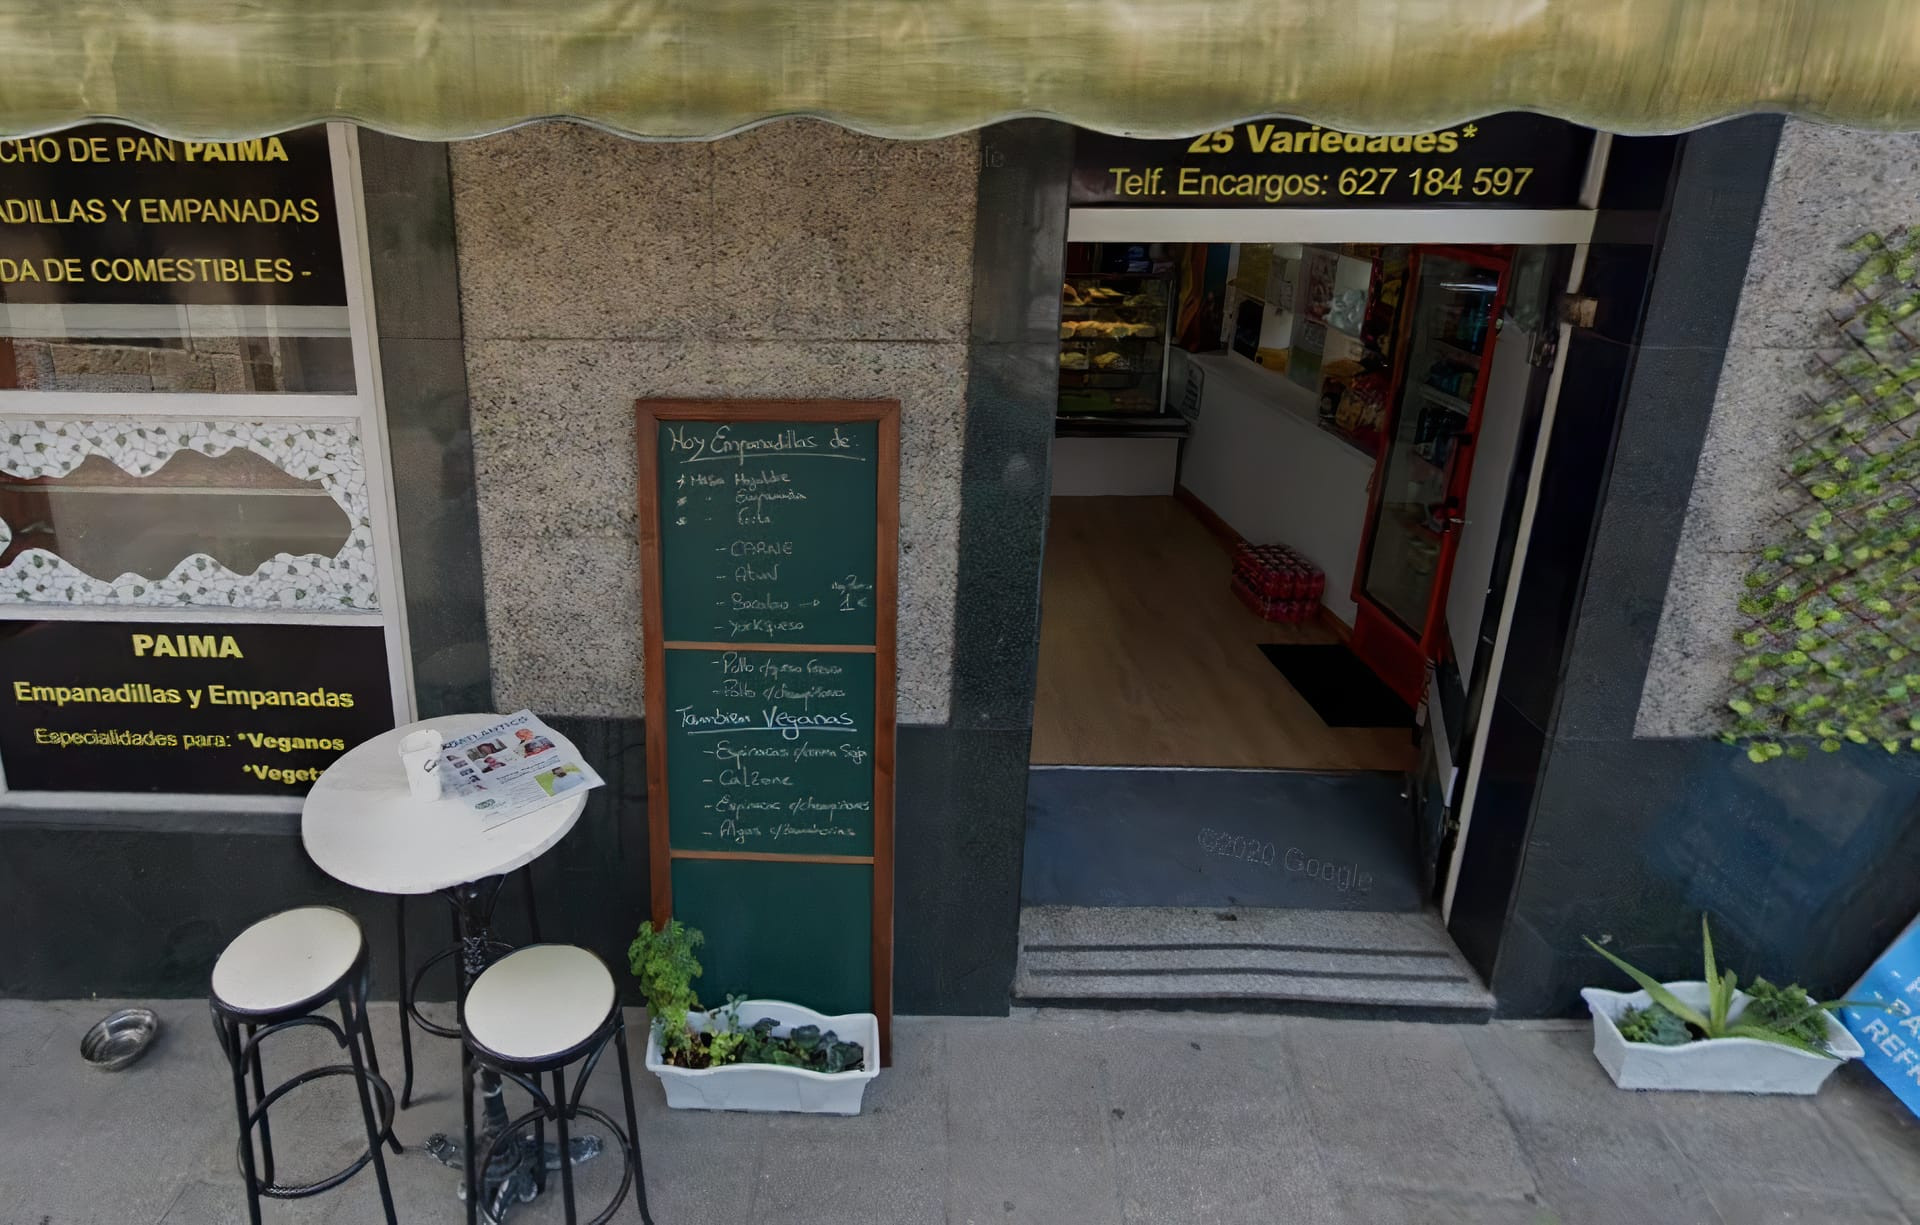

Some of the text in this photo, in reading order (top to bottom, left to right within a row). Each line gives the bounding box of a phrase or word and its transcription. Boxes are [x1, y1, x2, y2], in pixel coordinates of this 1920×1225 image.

[68, 137, 111, 163] DE
[117, 137, 176, 163] PAN
[184, 136, 289, 162] PAIMA
[1187, 126, 1235, 154] 25
[1108, 167, 1535, 203] Telf. Encargos: 627 184 597
[111, 198, 133, 224] Y
[141, 198, 321, 224] EMPANADAS
[43, 258, 85, 283] DE
[91, 258, 294, 283] COMESTIBLES
[668, 425, 706, 461] Hoy
[131, 633, 245, 660] PAIMA
[13, 681, 355, 710] Empanadillas y Empanadas
[761, 706, 855, 740] Veganas
[34, 727, 178, 749] Especialidades
[184, 733, 232, 750] para:
[242, 764, 327, 784] Veget
